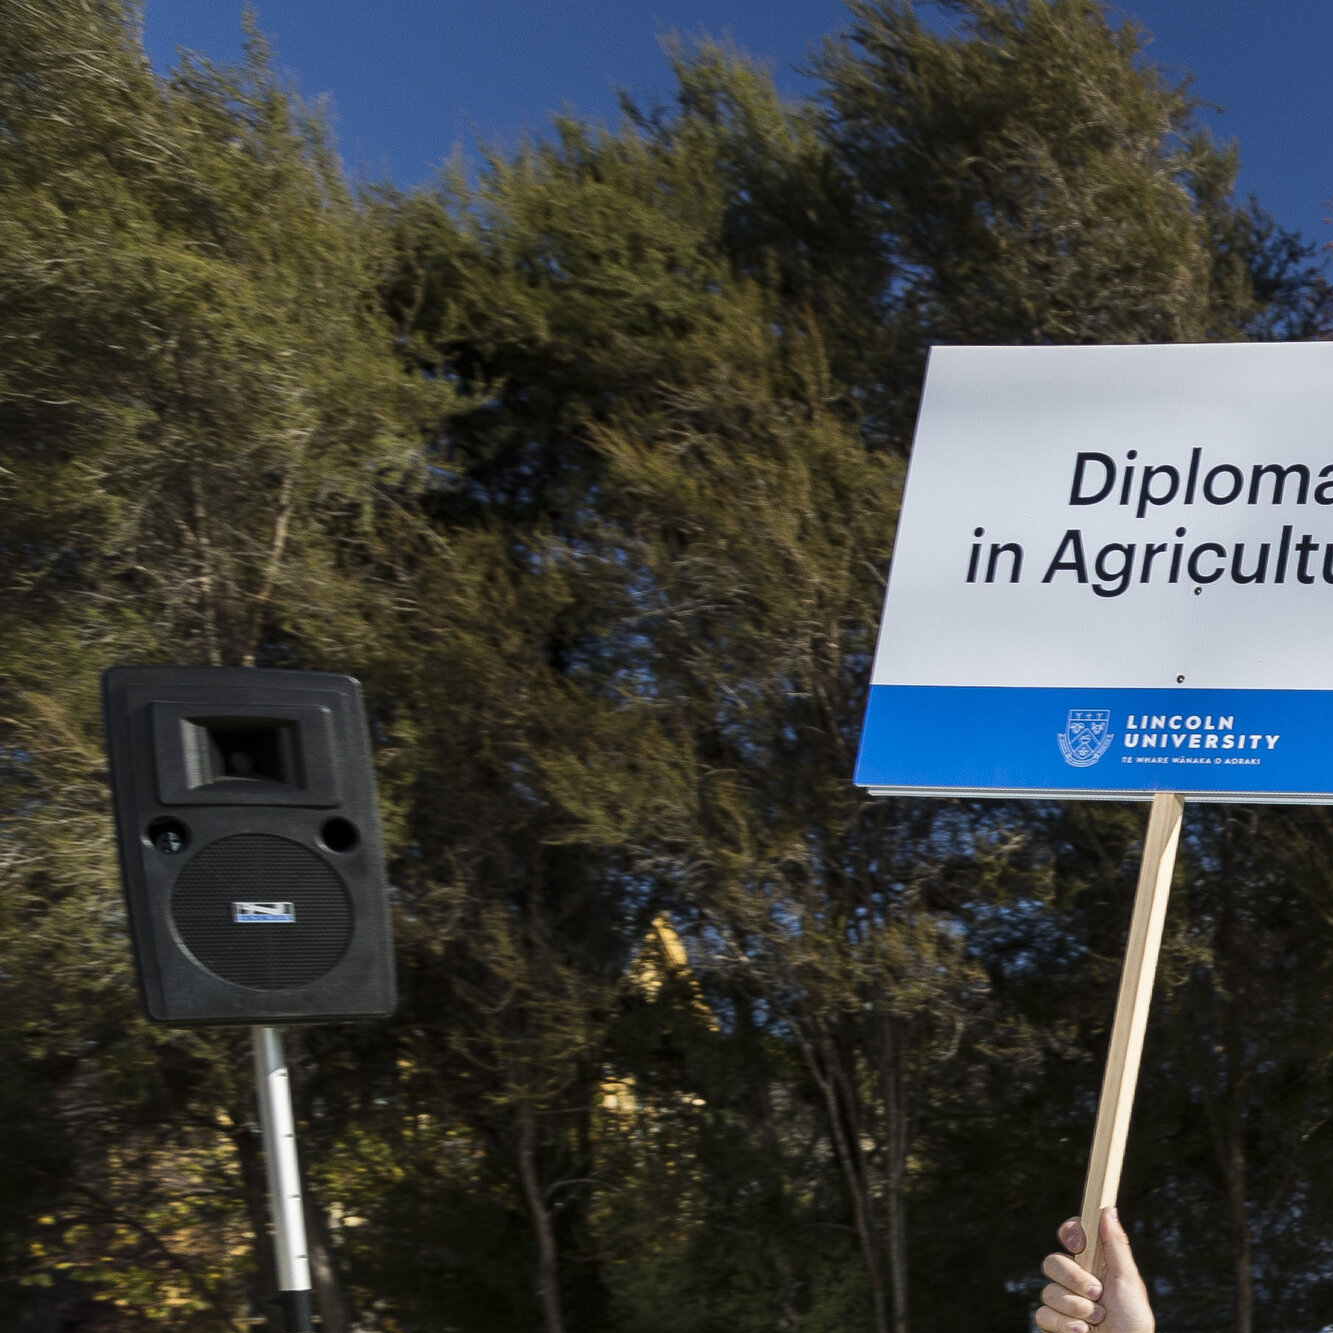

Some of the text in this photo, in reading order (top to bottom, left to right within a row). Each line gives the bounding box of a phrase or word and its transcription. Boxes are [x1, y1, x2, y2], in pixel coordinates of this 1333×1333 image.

[966, 526, 1023, 585] in
[1126, 714, 1235, 730] LINCOLN
[1123, 733, 1280, 750] UNIVERSITY
[1121, 755, 1261, 766] TE WHARE WĀNAKA O AORAKI
